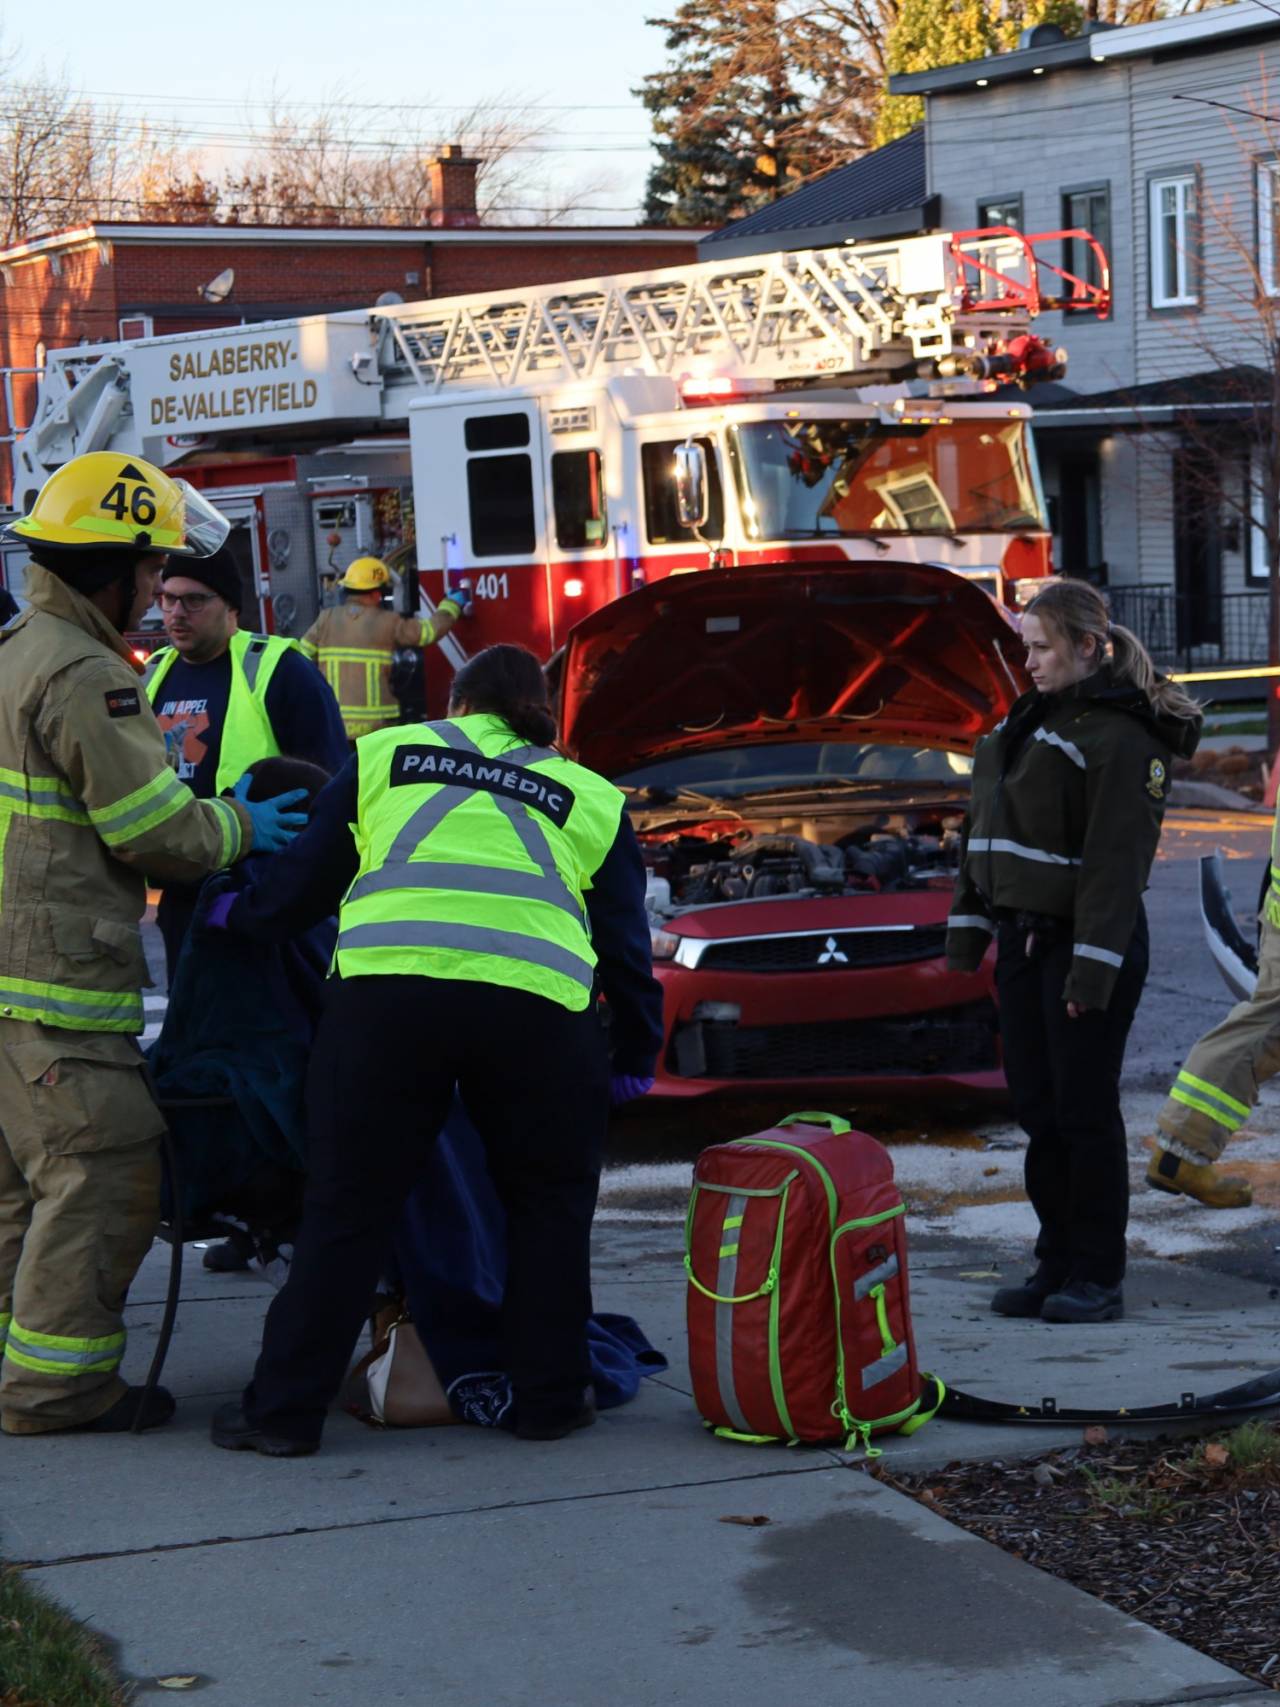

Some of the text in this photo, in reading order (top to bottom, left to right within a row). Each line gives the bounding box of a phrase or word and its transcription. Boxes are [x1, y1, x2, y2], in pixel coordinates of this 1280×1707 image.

[169, 340, 298, 381] SALABERRY-
[151, 379, 318, 425] DE-VALLEYFIELD
[100, 482, 157, 526] 46
[475, 573, 509, 599] 401
[176, 699, 208, 714] APPEL
[402, 755, 563, 812] PARAMÉDIC
